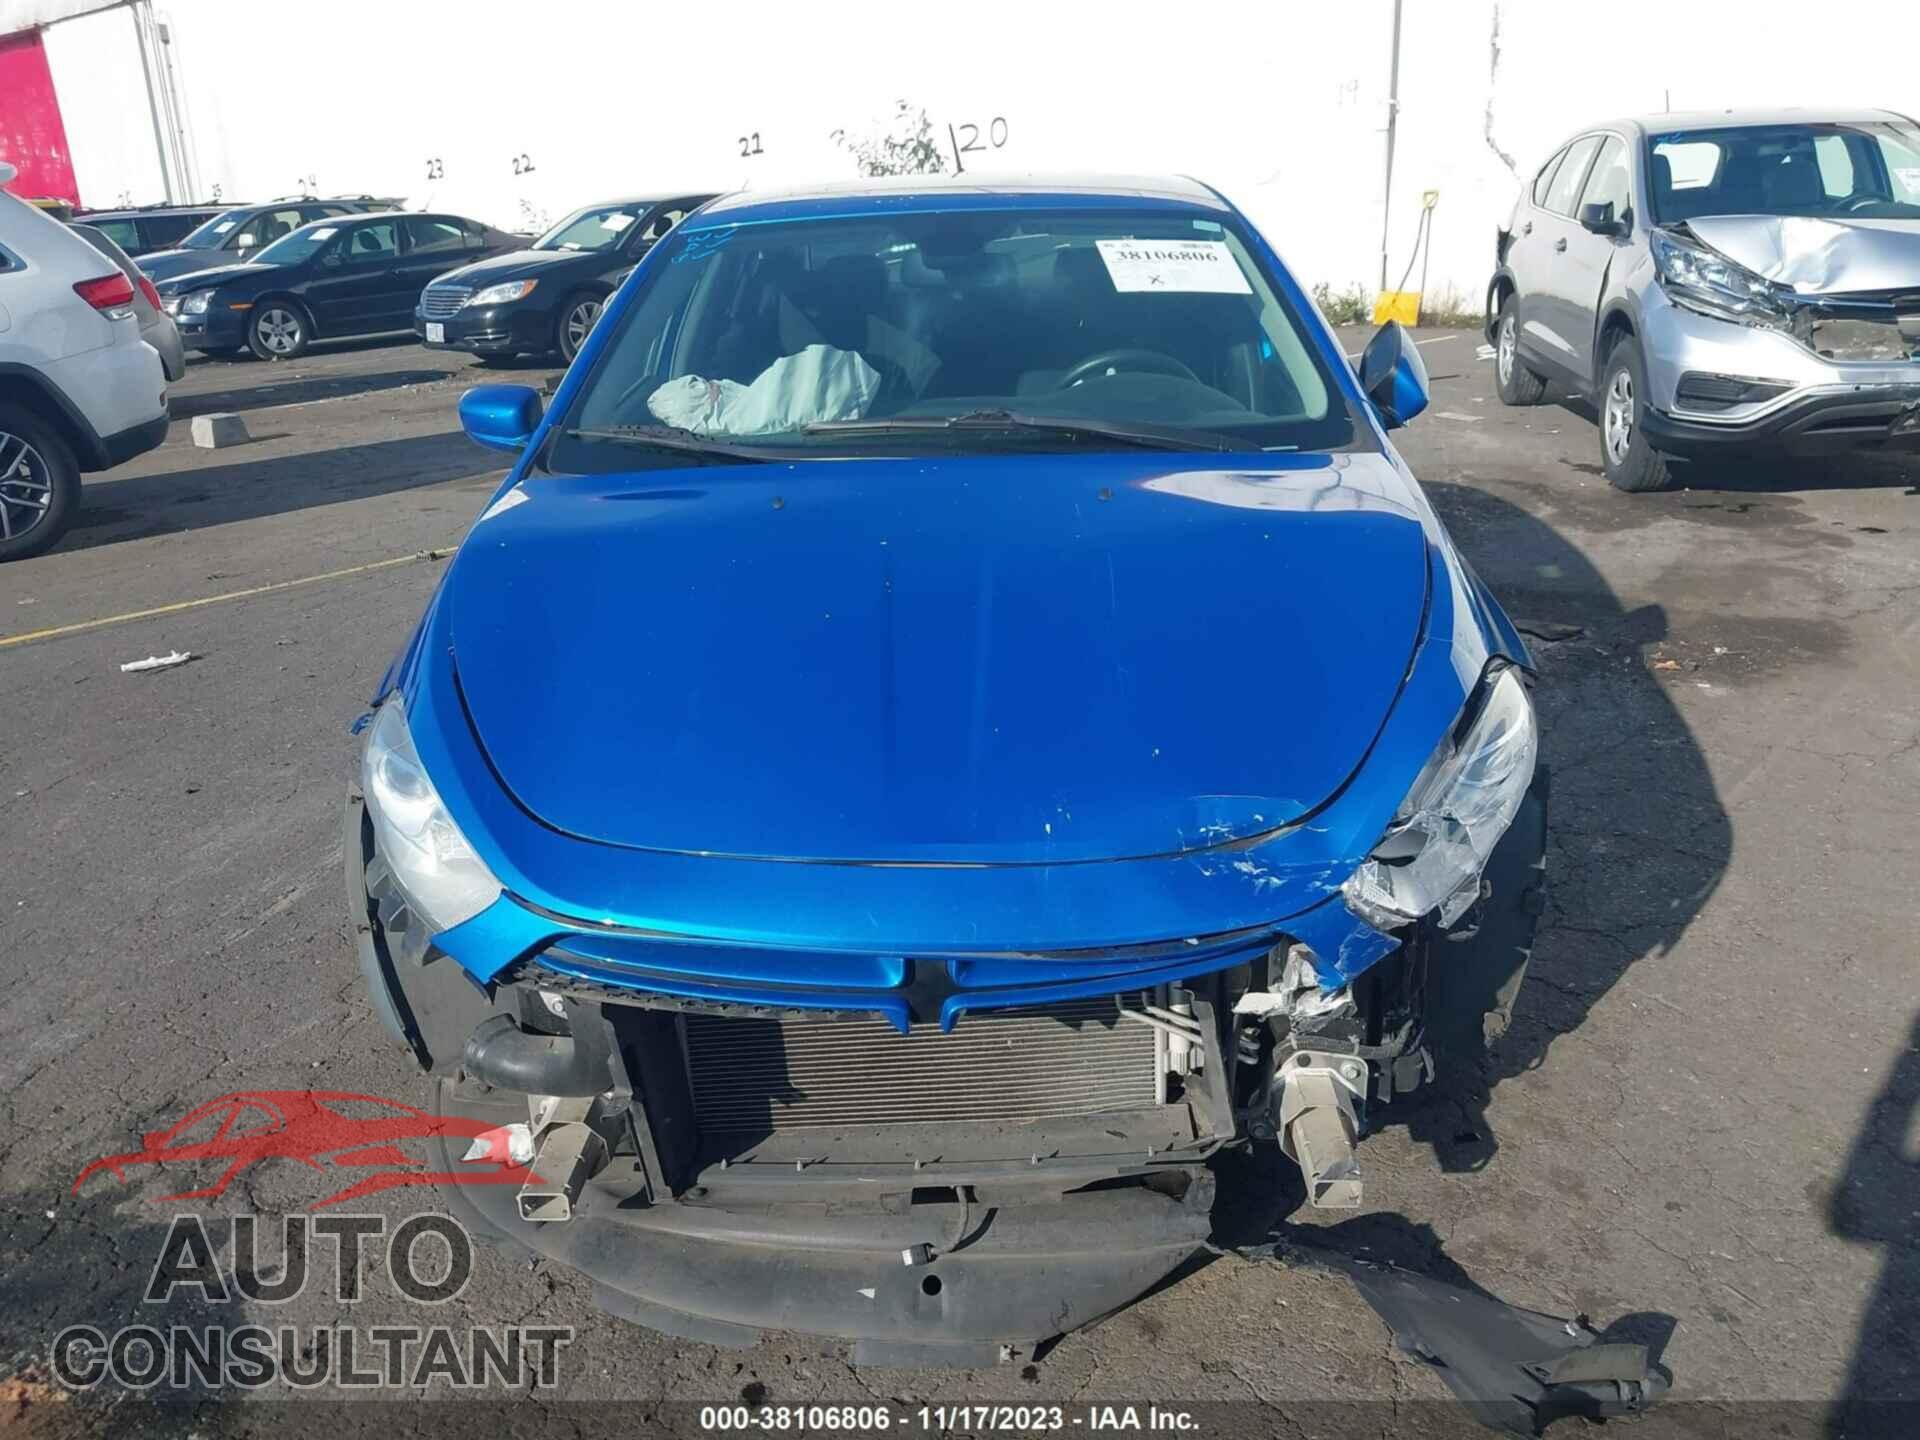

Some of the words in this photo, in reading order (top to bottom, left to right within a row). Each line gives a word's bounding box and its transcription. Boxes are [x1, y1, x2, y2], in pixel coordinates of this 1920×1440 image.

[739, 132, 764, 157] 21
[426, 158, 444, 180] 23
[512, 153, 536, 175] 22
[1116, 250, 1219, 262] 38106806
